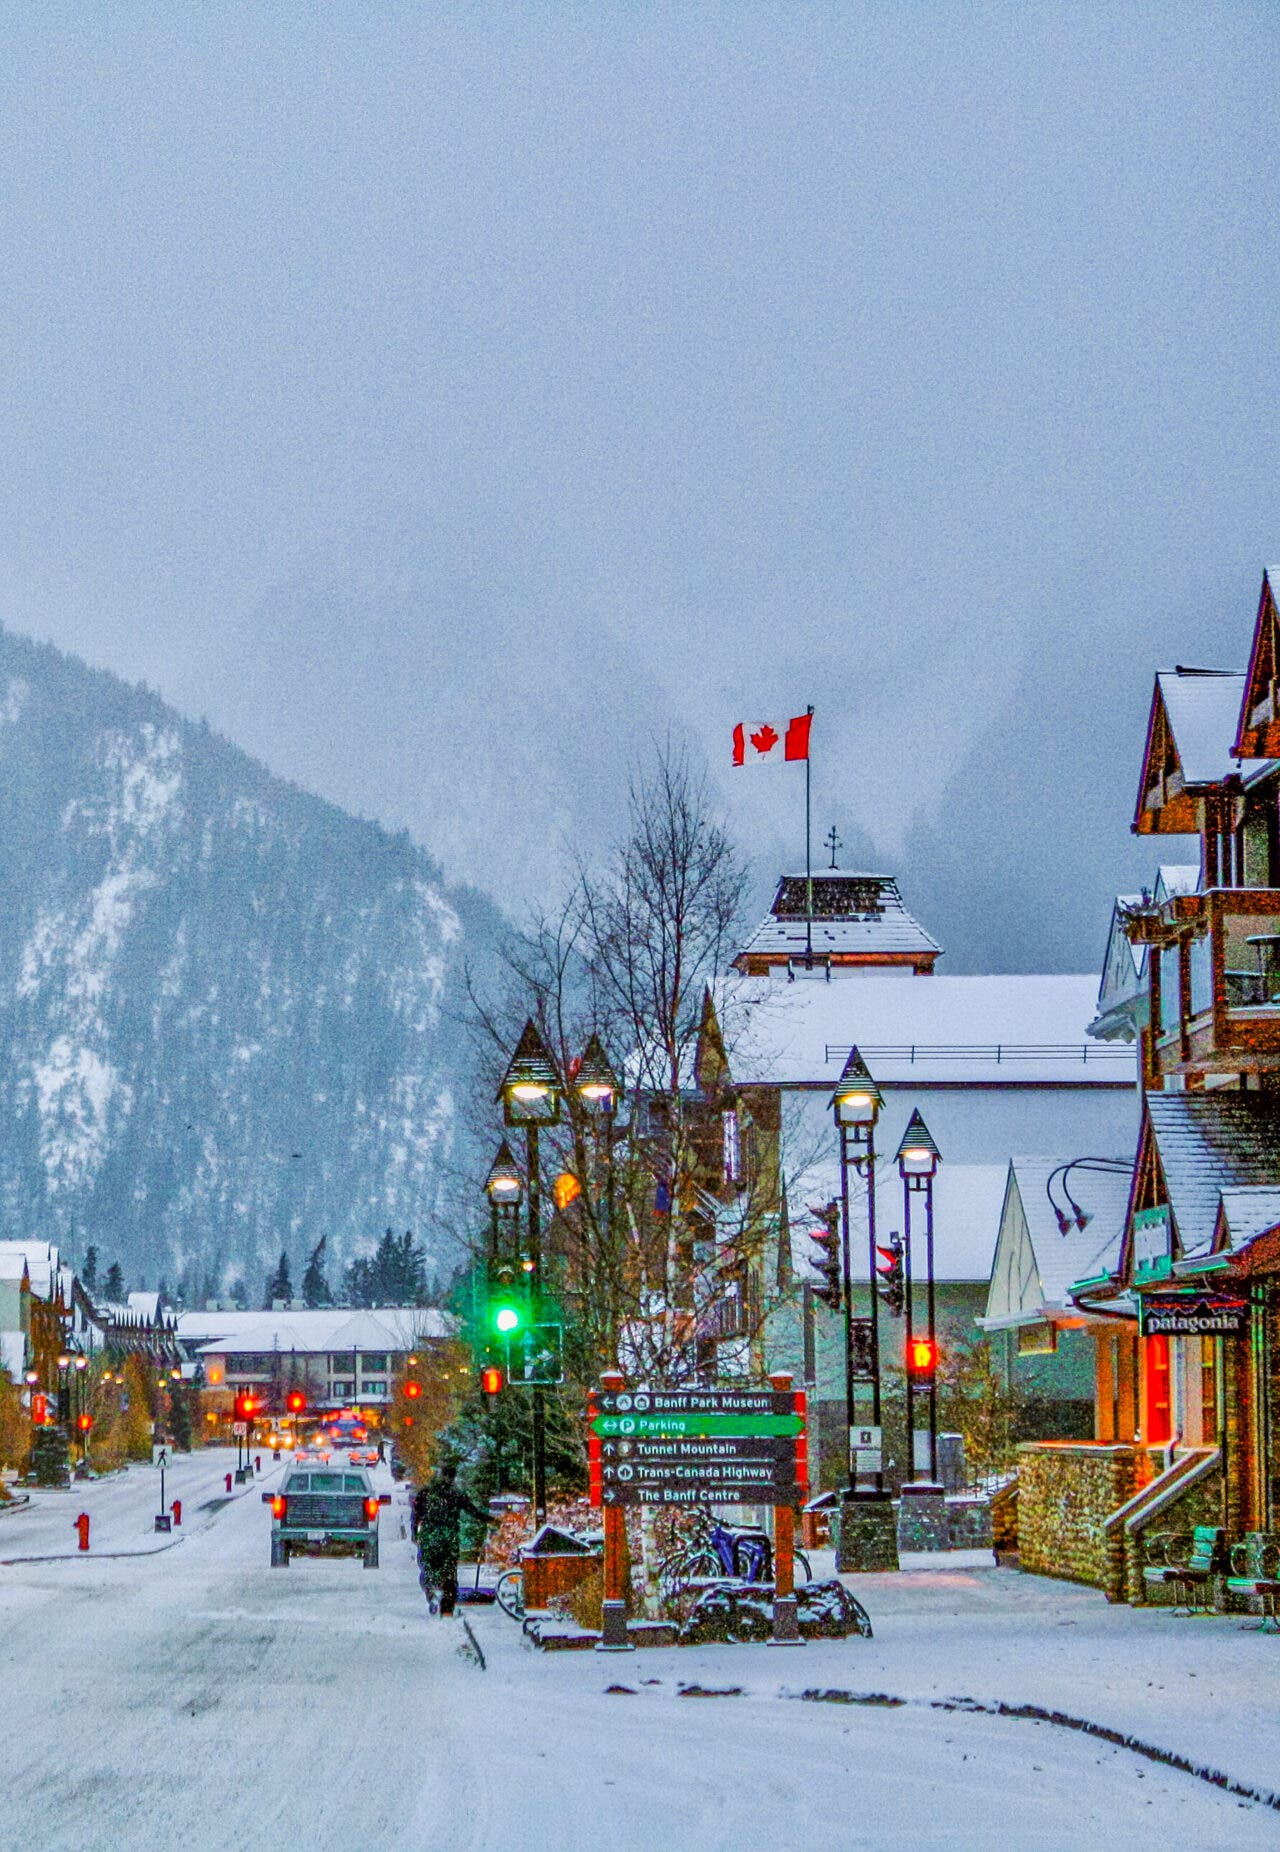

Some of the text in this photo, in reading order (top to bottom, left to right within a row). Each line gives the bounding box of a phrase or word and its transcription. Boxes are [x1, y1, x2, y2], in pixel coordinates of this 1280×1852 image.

[1148, 1314, 1239, 1333] patagonia
[655, 1397, 687, 1408] Banff
[691, 1397, 718, 1408] Park
[640, 1420, 686, 1431] Parking
[638, 1444, 737, 1454] Tunnel Mountain
[638, 1466, 773, 1479] Trans-Canada Highway
[638, 1489, 740, 1501] The Banff Centre
